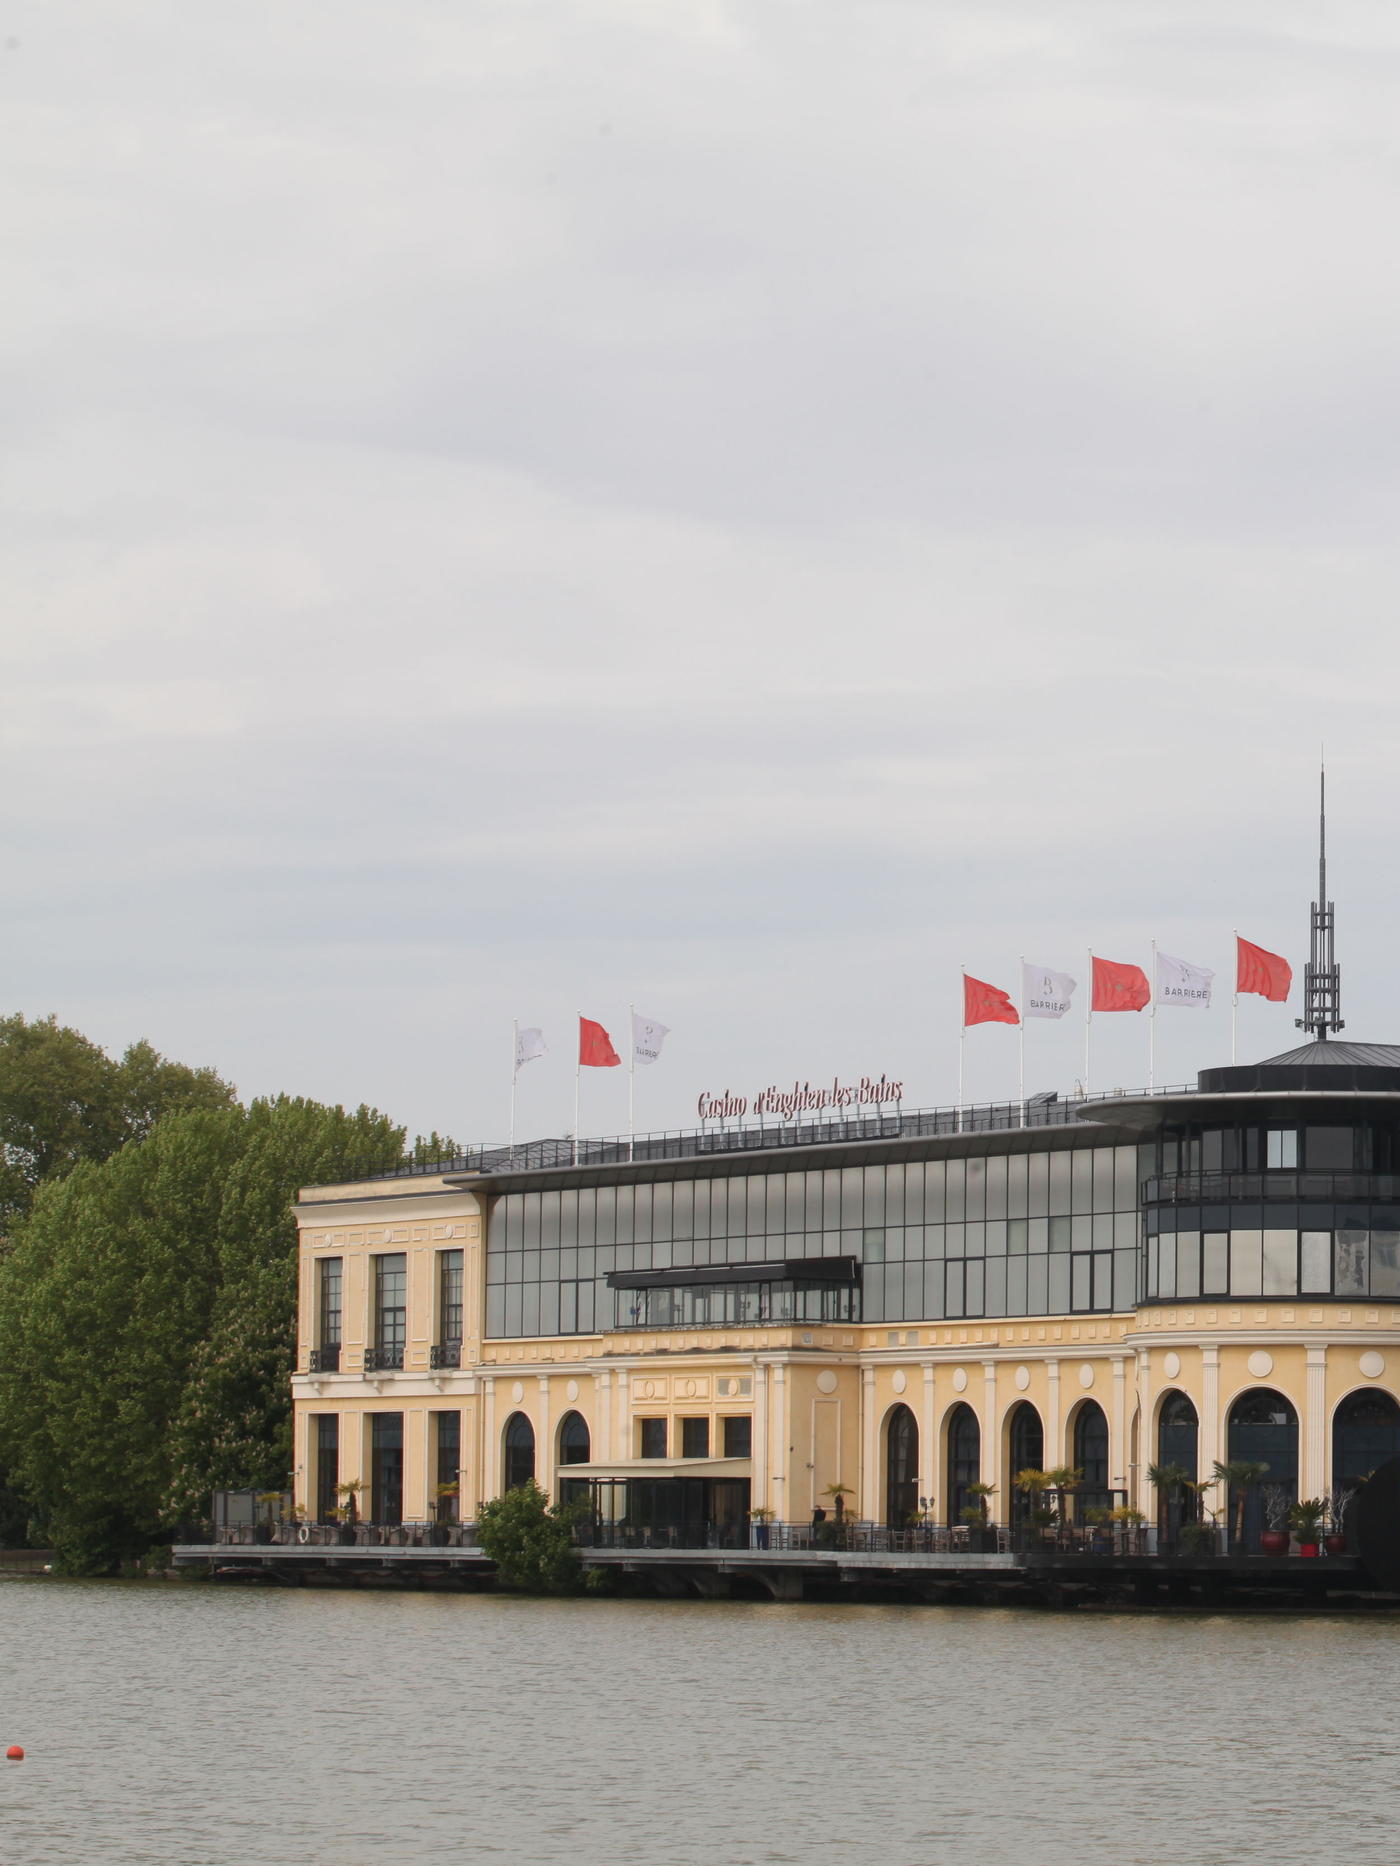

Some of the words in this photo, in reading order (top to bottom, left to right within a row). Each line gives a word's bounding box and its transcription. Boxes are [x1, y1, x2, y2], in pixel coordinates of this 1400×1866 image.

[1030, 999, 1066, 1012] BARRIER
[698, 1088, 748, 1119] Casino
[752, 1081, 827, 1122] d'Enghien
[829, 1076, 853, 1108] les
[856, 1073, 904, 1106] Bains
